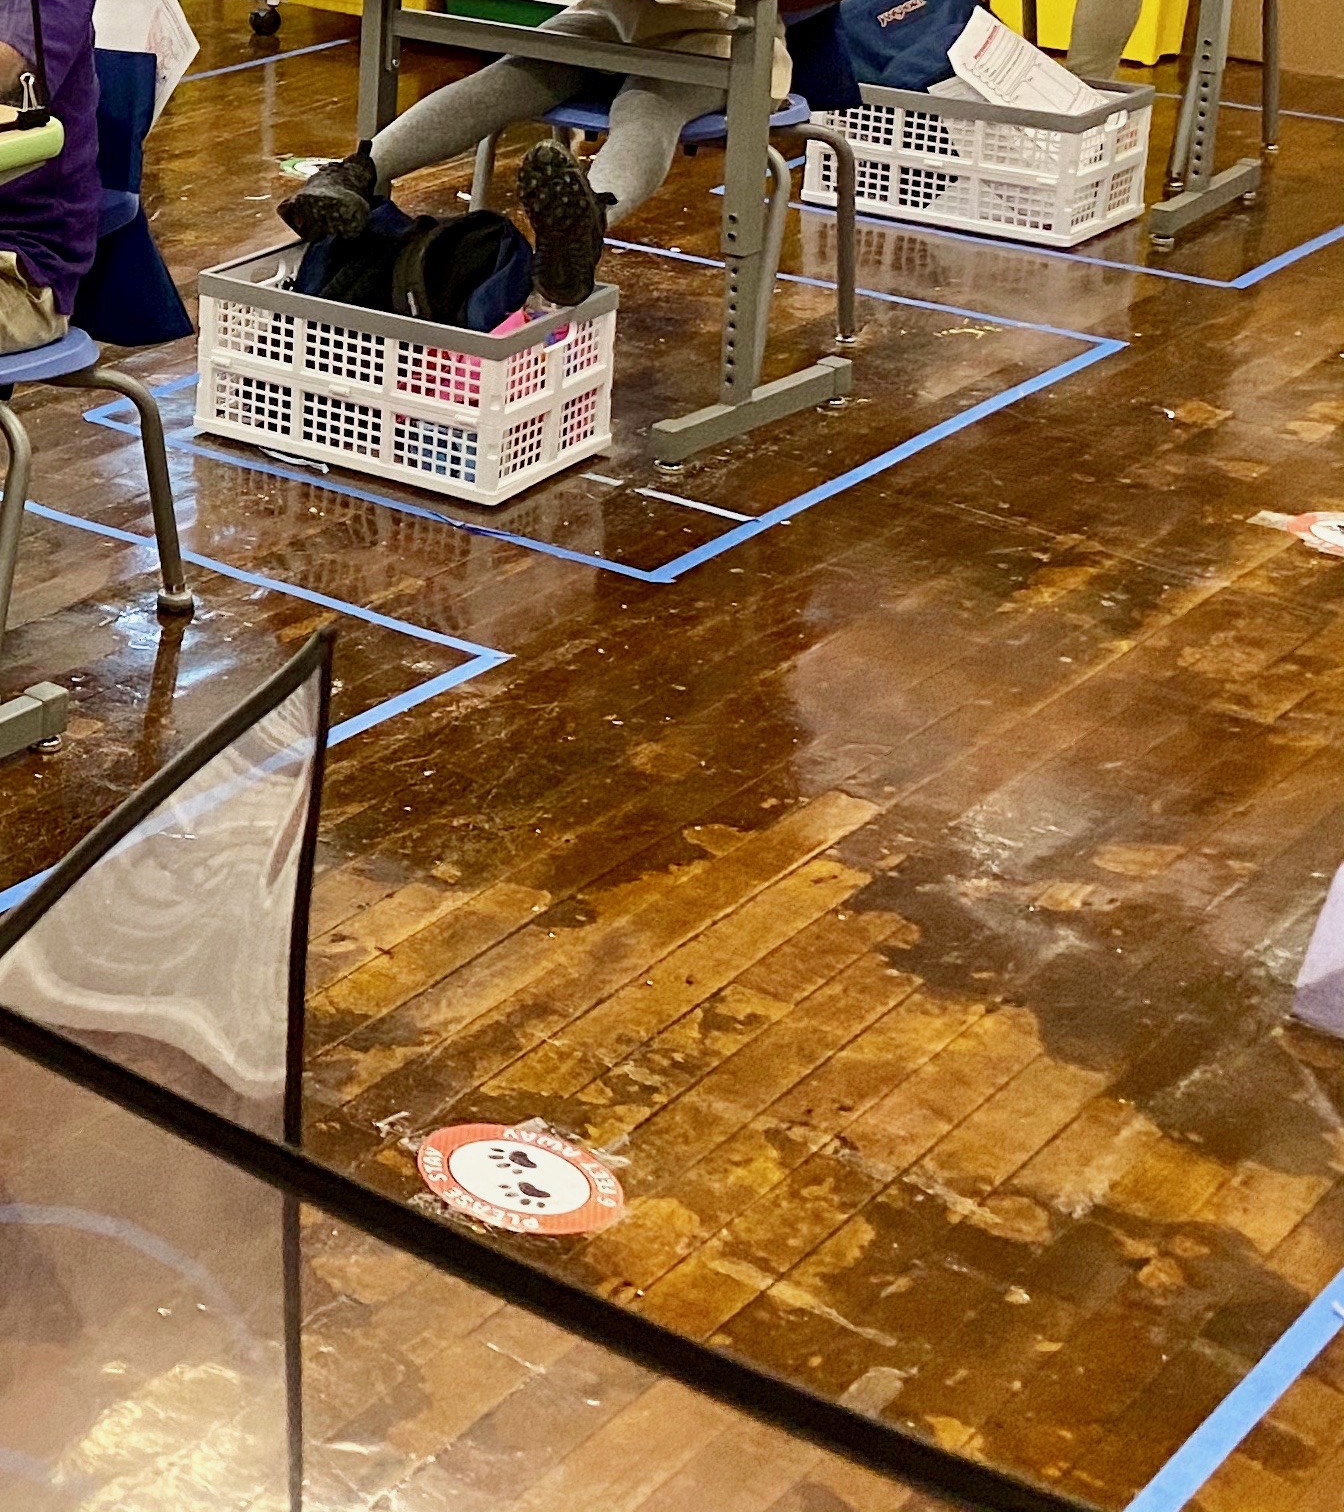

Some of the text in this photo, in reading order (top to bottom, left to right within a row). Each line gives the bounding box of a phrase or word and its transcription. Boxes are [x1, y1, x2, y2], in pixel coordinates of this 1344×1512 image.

[503, 1128, 582, 1158] AWAY
[422, 1146, 540, 1230] PLEASE STAY
[579, 1161, 617, 1195] FEET
